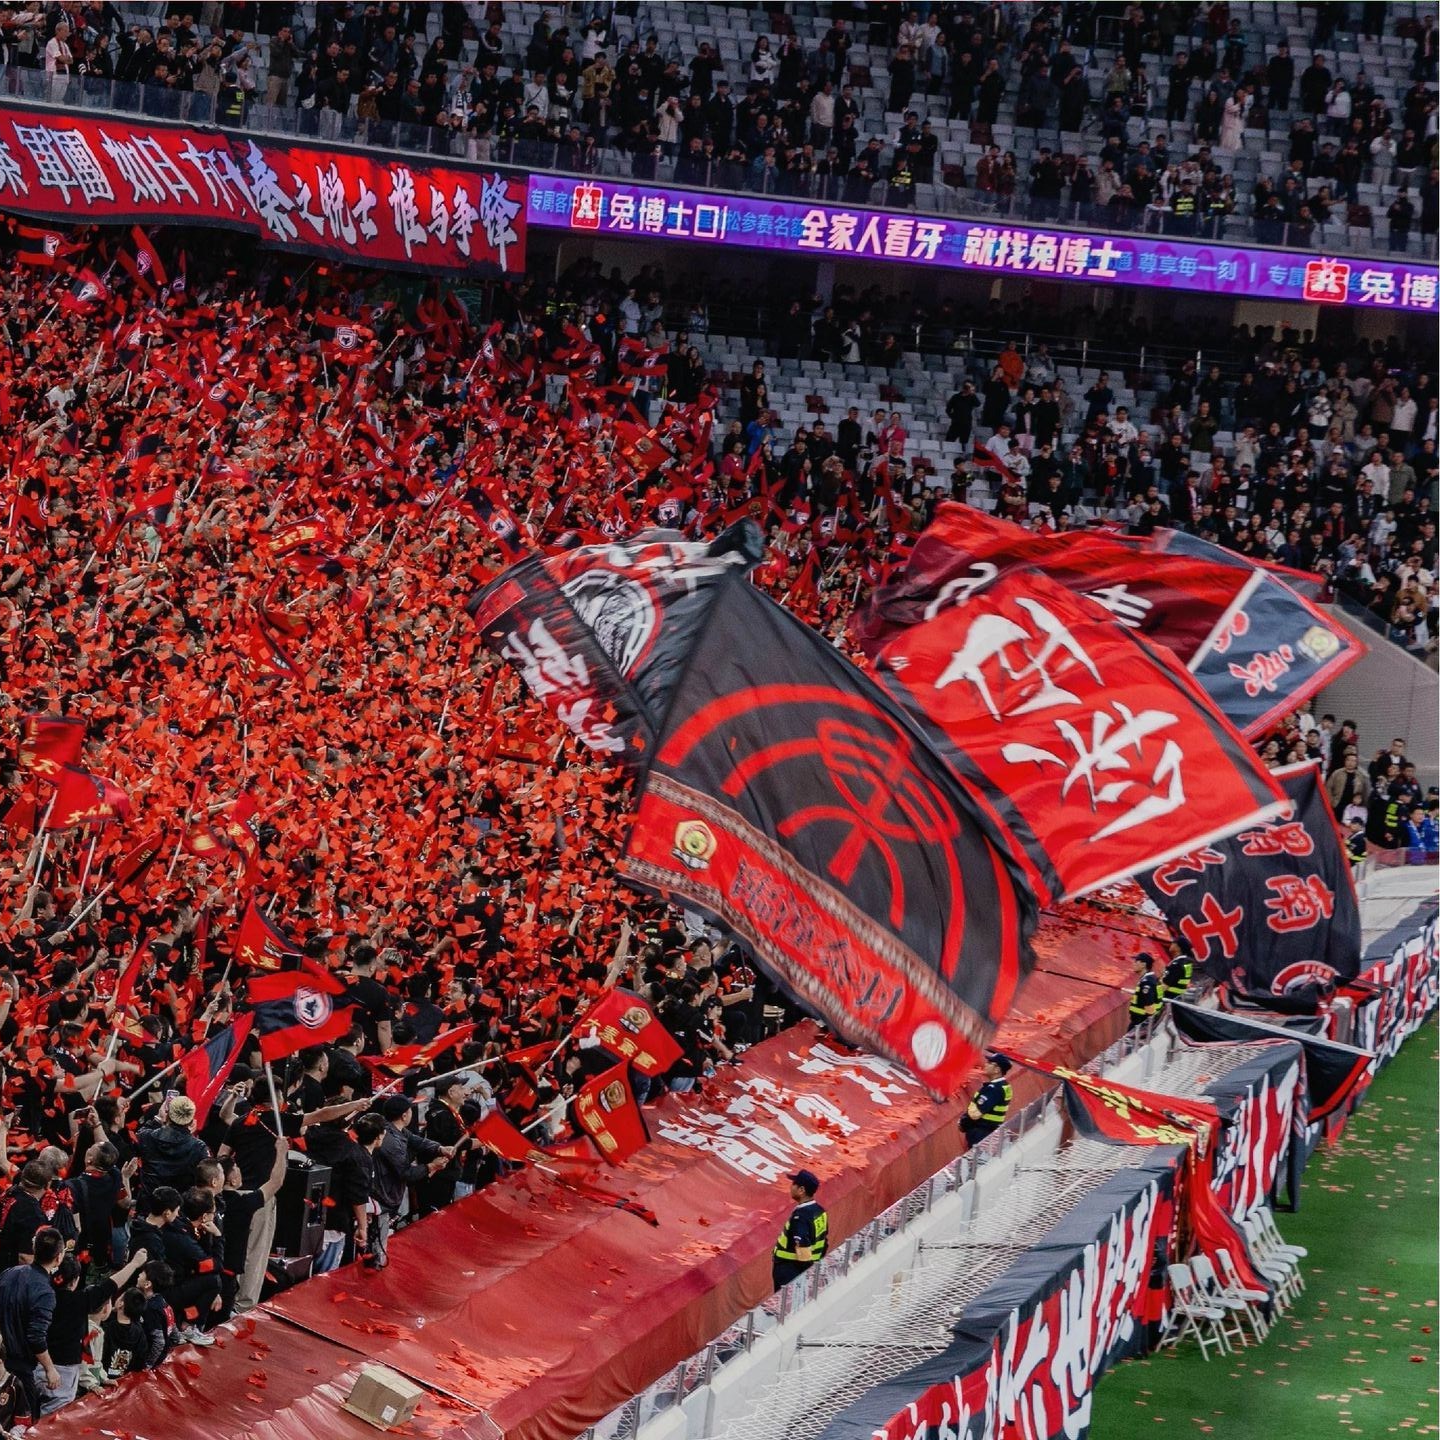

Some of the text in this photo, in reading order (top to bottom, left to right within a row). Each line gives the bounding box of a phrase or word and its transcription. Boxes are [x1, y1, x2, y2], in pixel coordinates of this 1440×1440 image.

[797, 208, 1123, 279] 全家人看牙 就找兔博士
[1138, 251, 1238, 282] 尊享每一刻
